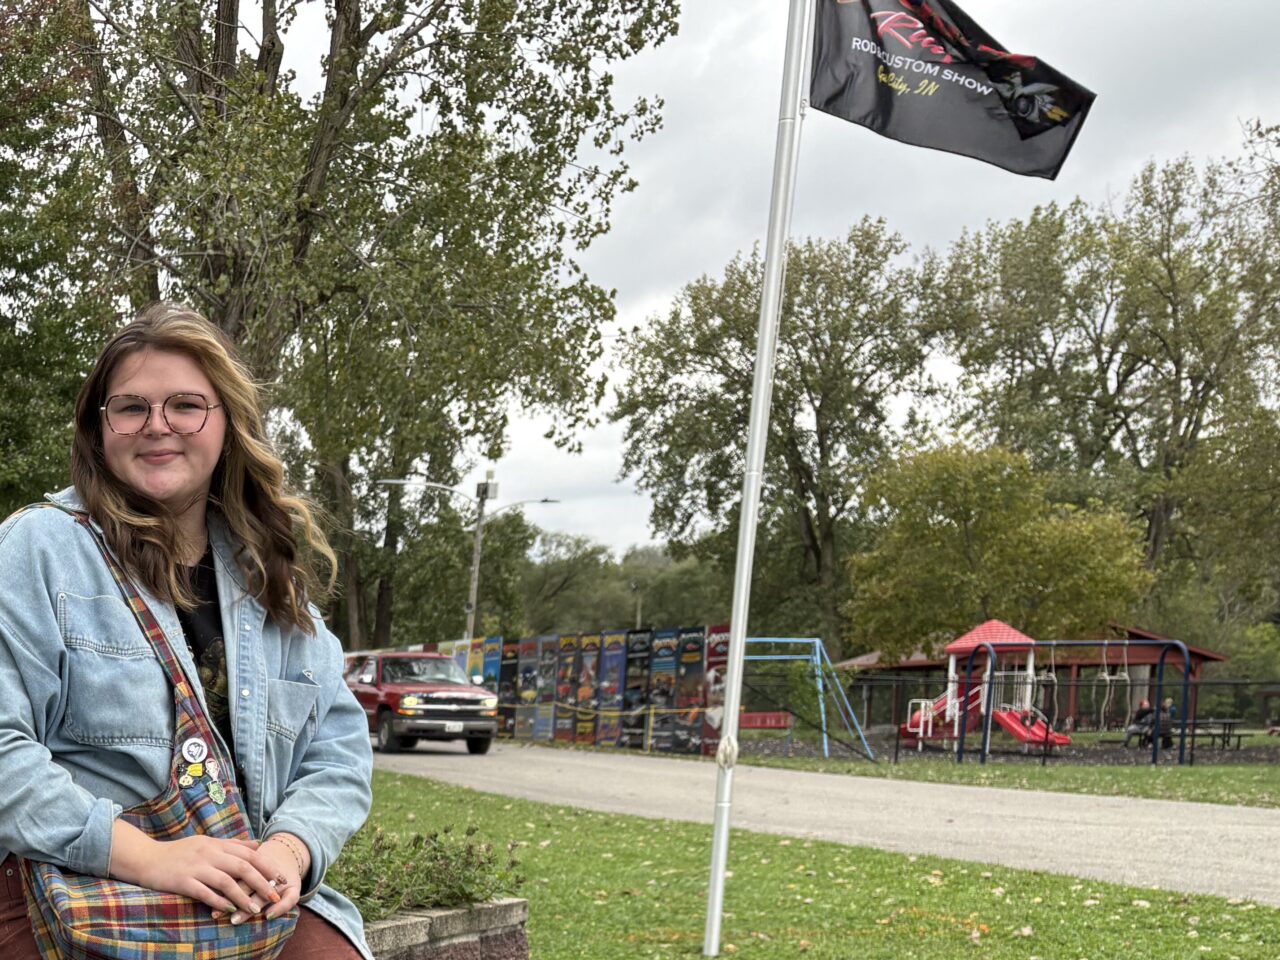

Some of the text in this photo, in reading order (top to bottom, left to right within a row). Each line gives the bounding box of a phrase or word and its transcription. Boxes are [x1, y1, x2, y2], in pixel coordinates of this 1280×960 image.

[851, 37, 877, 54] ROD
[881, 51, 940, 77] CUSTOM
[941, 69, 993, 96] SHOW
[913, 79, 940, 96] IN
